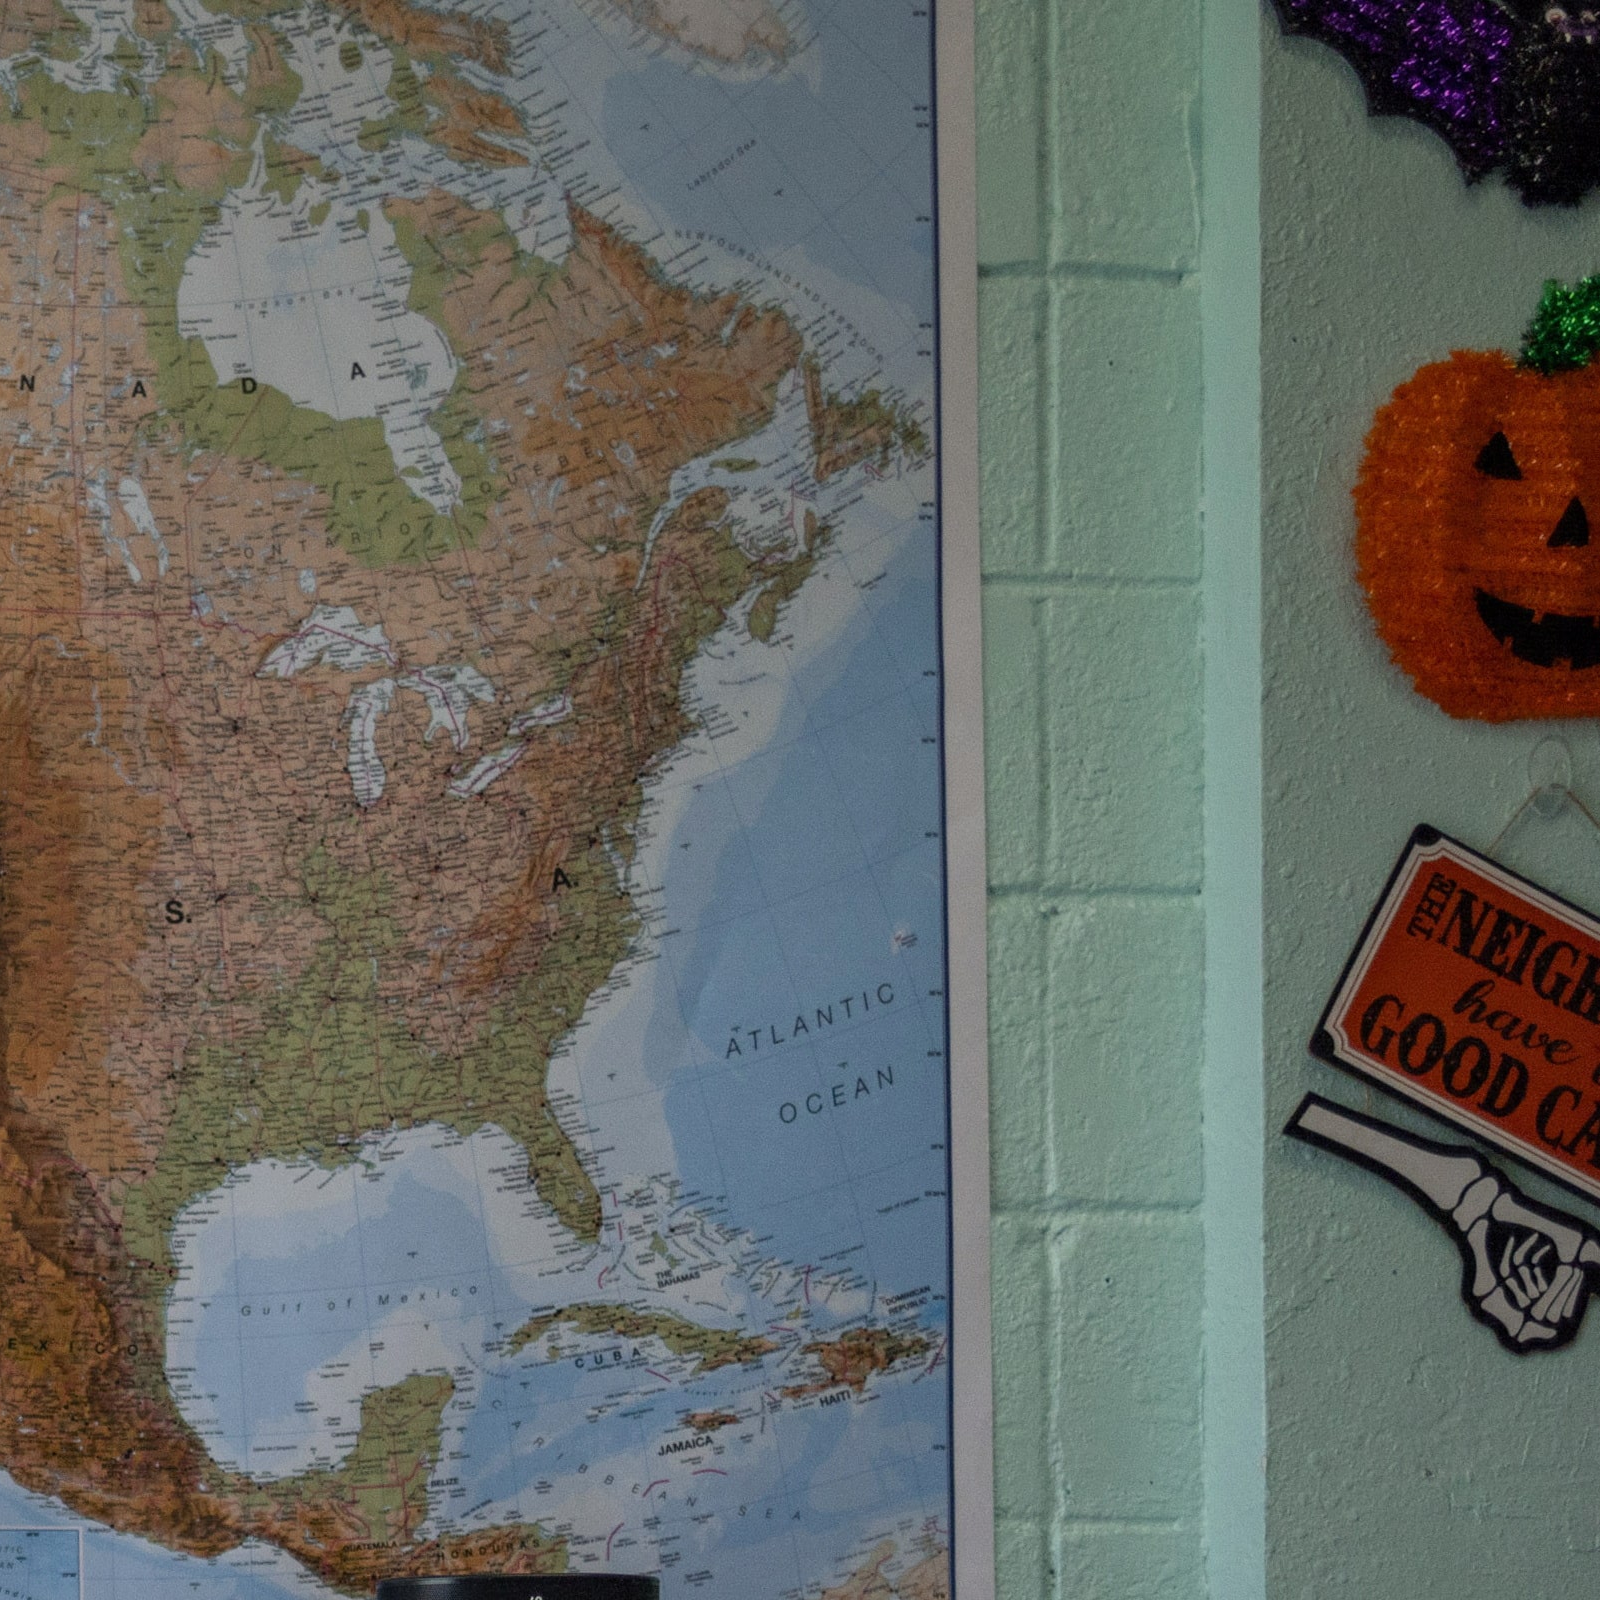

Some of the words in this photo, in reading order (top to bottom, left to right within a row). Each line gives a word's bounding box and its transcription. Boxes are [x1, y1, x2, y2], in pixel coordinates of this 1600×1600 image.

[1406, 872, 1458, 941] THE
[725, 982, 895, 1060] ATLANTIC
[1452, 979, 1582, 1066] have
[1359, 994, 1529, 1118] GOOD
[779, 1068, 895, 1125] OCEAN
[656, 1269, 673, 1279] THE
[657, 1271, 700, 1289] BAHAMAS
[241, 1303, 301, 1317] Gulf
[328, 1297, 351, 1311] of
[378, 1286, 477, 1306] Mexico
[885, 1285, 930, 1306] DOMINICAN
[575, 1348, 641, 1369] CUBA
[819, 1391, 852, 1408] HAITI
[658, 1435, 713, 1457] JAMAICA
[492, 1399, 697, 1507] CARIBBEAN
[738, 1505, 801, 1520] SEA
[437, 1539, 540, 1560] HONDURAS
